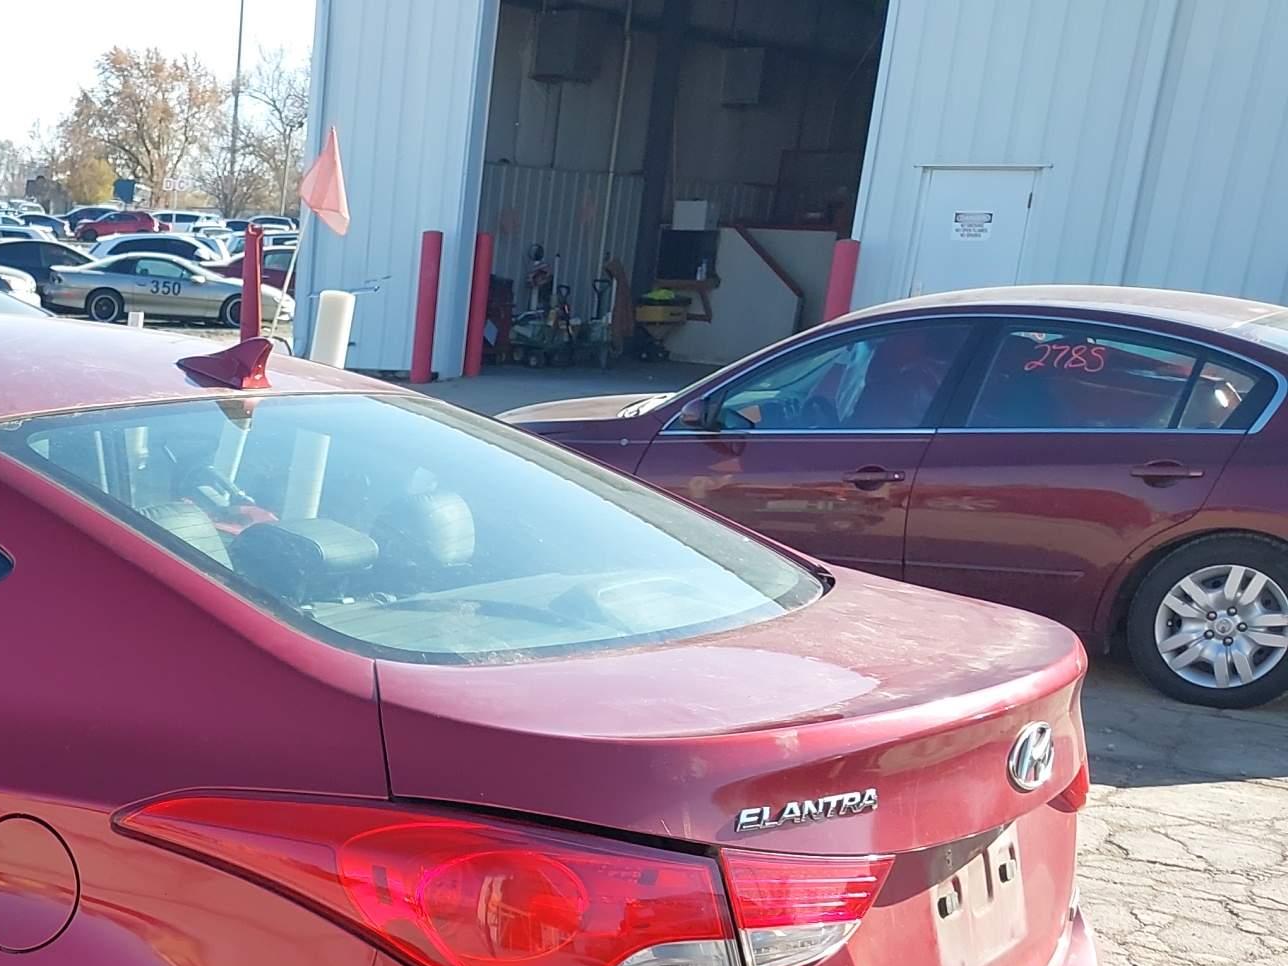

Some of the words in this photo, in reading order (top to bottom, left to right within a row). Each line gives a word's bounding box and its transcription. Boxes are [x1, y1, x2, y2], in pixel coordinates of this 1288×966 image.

[150, 280, 181, 296] 350
[1024, 344, 1105, 372] 2785
[735, 788, 878, 832] ELANTRA
